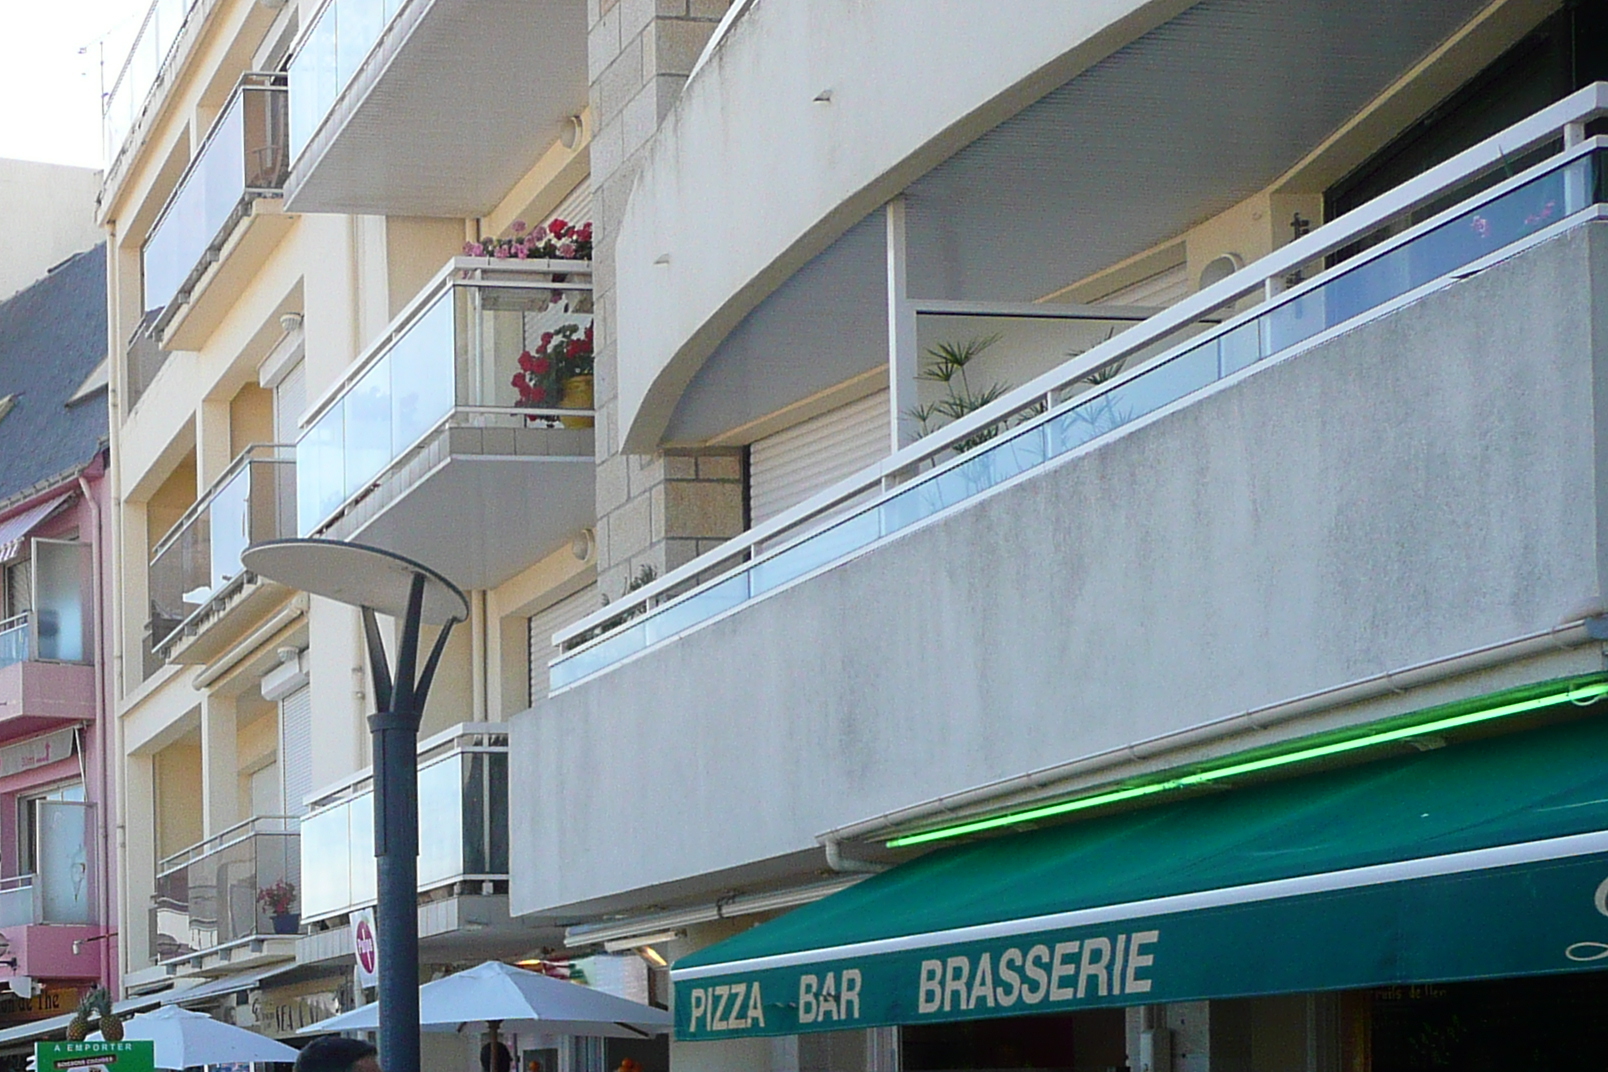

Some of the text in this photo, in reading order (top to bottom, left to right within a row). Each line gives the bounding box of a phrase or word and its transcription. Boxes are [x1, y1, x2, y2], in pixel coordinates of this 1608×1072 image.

[689, 929, 1160, 1033] PIZZA BAR BRASSERIE
[66, 1043, 132, 1052] EMPORTER
